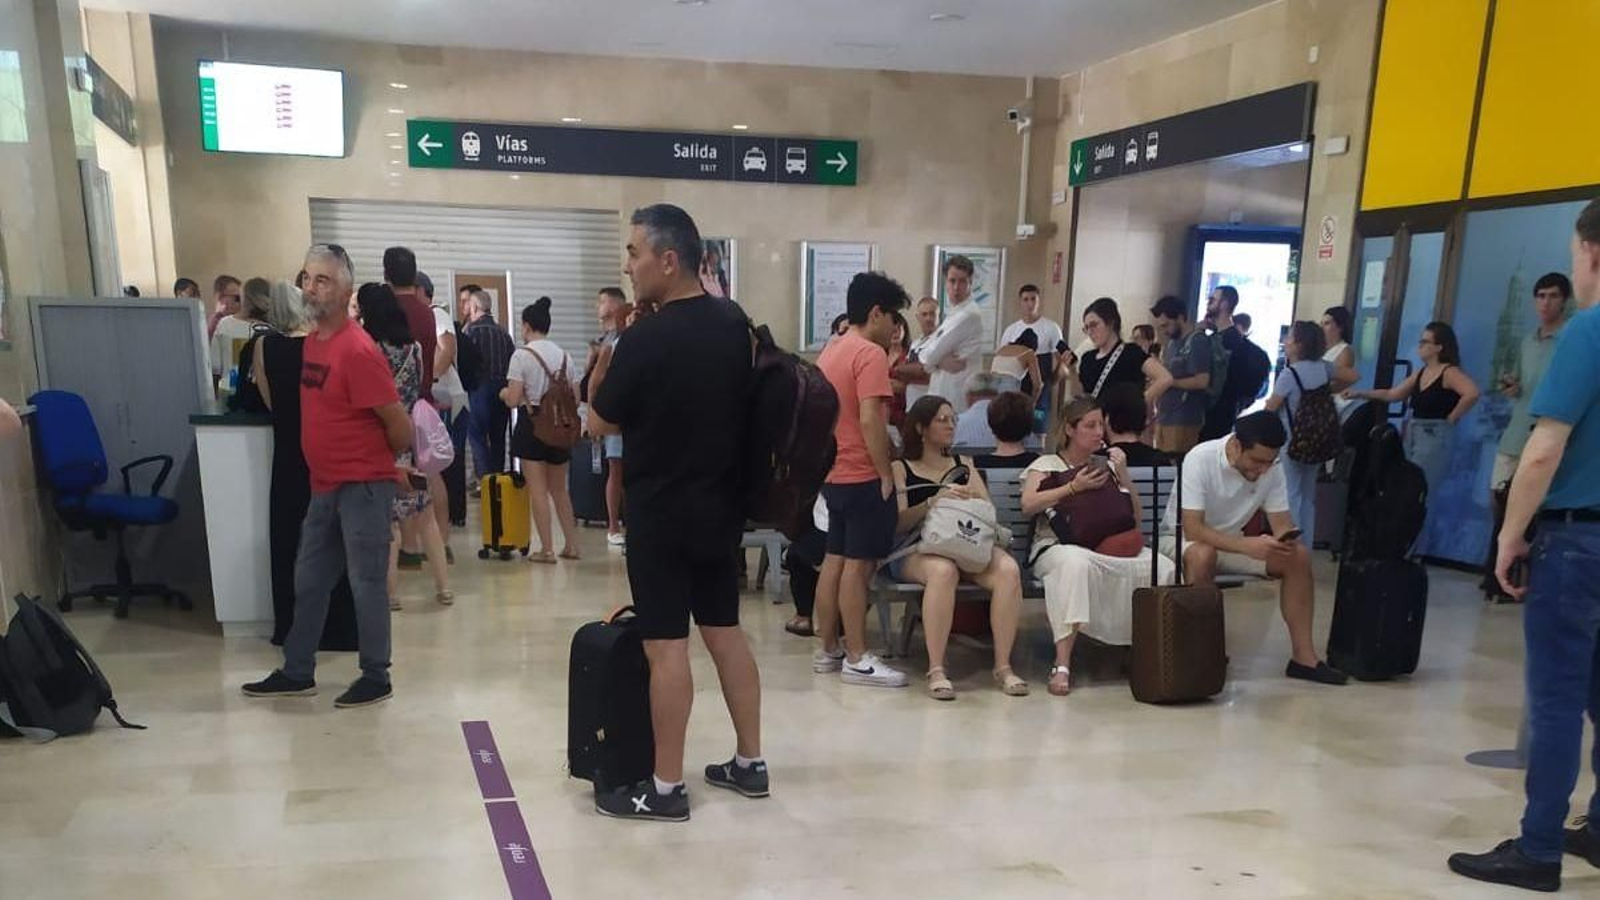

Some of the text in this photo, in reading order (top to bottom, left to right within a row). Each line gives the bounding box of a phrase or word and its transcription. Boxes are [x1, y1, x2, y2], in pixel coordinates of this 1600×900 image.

[495, 134, 528, 151] Vías
[673, 142, 717, 159] Salida
[497, 154, 546, 165] PLATFORMS
[1094, 142, 1115, 161] Salida
